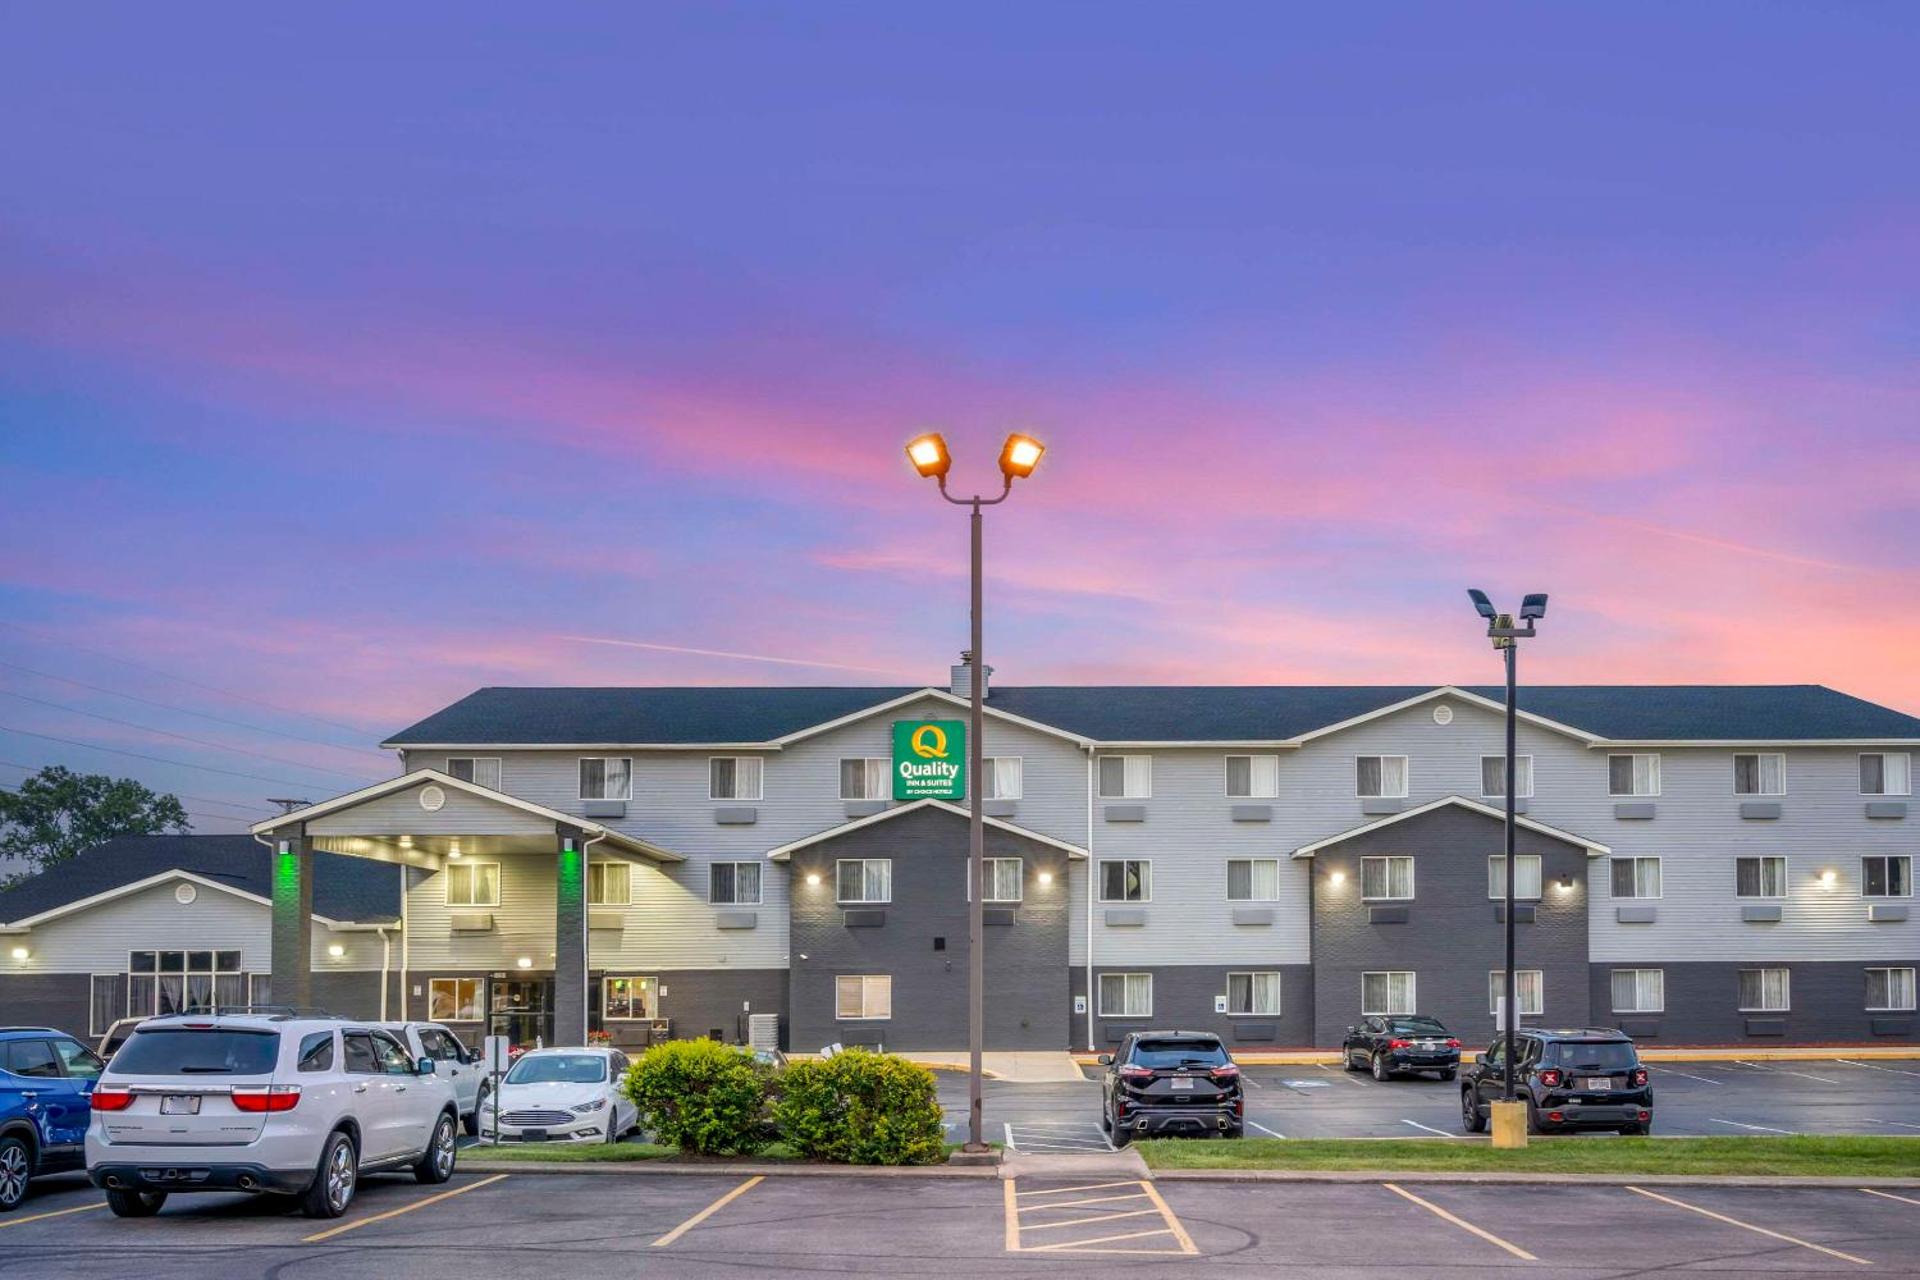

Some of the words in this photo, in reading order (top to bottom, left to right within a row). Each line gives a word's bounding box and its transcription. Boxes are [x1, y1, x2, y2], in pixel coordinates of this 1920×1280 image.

[912, 725, 949, 758] Q
[899, 761, 959, 779] Quality
[906, 779, 920, 787] INN
[926, 779, 953, 787] SUITES
